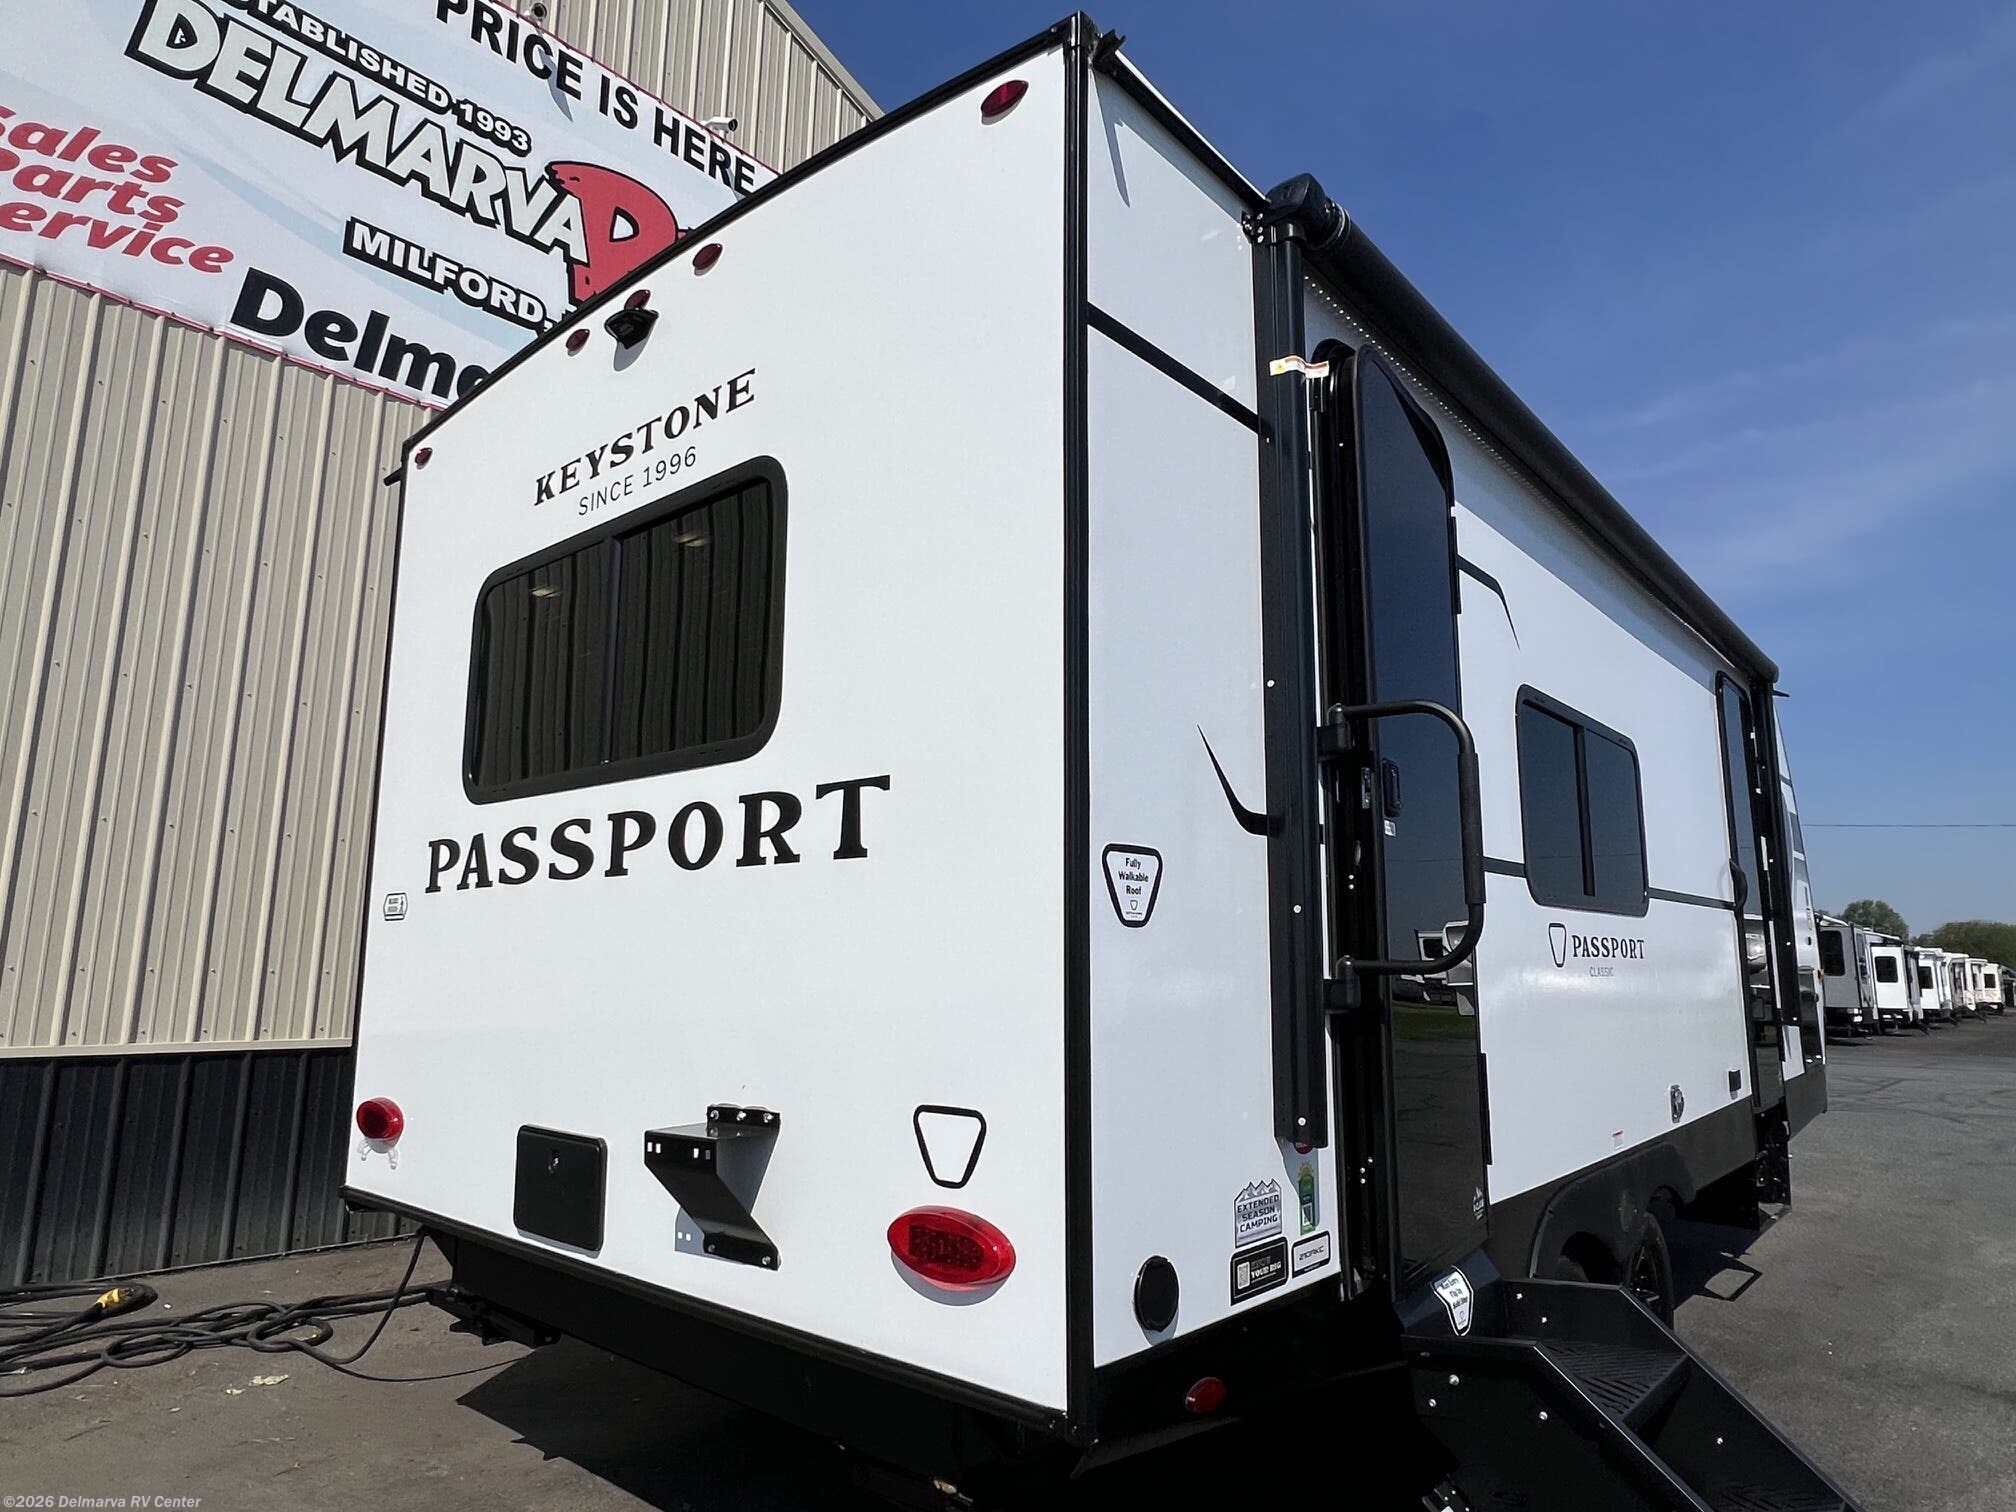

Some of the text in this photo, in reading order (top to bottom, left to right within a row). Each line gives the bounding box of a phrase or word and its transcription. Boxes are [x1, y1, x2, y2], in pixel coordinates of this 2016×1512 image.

[437, 0, 756, 198] PRICE IS HERE
[125, 0, 590, 267] DELMARVA
[458, 99, 532, 153] 1993
[0, 201, 234, 273] ervice
[533, 367, 756, 506] KEYSTONE
[578, 446, 697, 516] SINCE 1996
[424, 774, 891, 894] PASSPORT
[1118, 870, 1149, 882] Walkable
[1125, 857, 1142, 870] Fully
[1126, 884, 1142, 895] Roof
[1571, 934, 1645, 959] PASSPORT
[1589, 966, 1614, 977] CLASSIC
[1237, 1194, 1280, 1213] EXTENDED
[1242, 1205, 1275, 1222] SEASON
[1240, 1214, 1278, 1232] CAMPING
